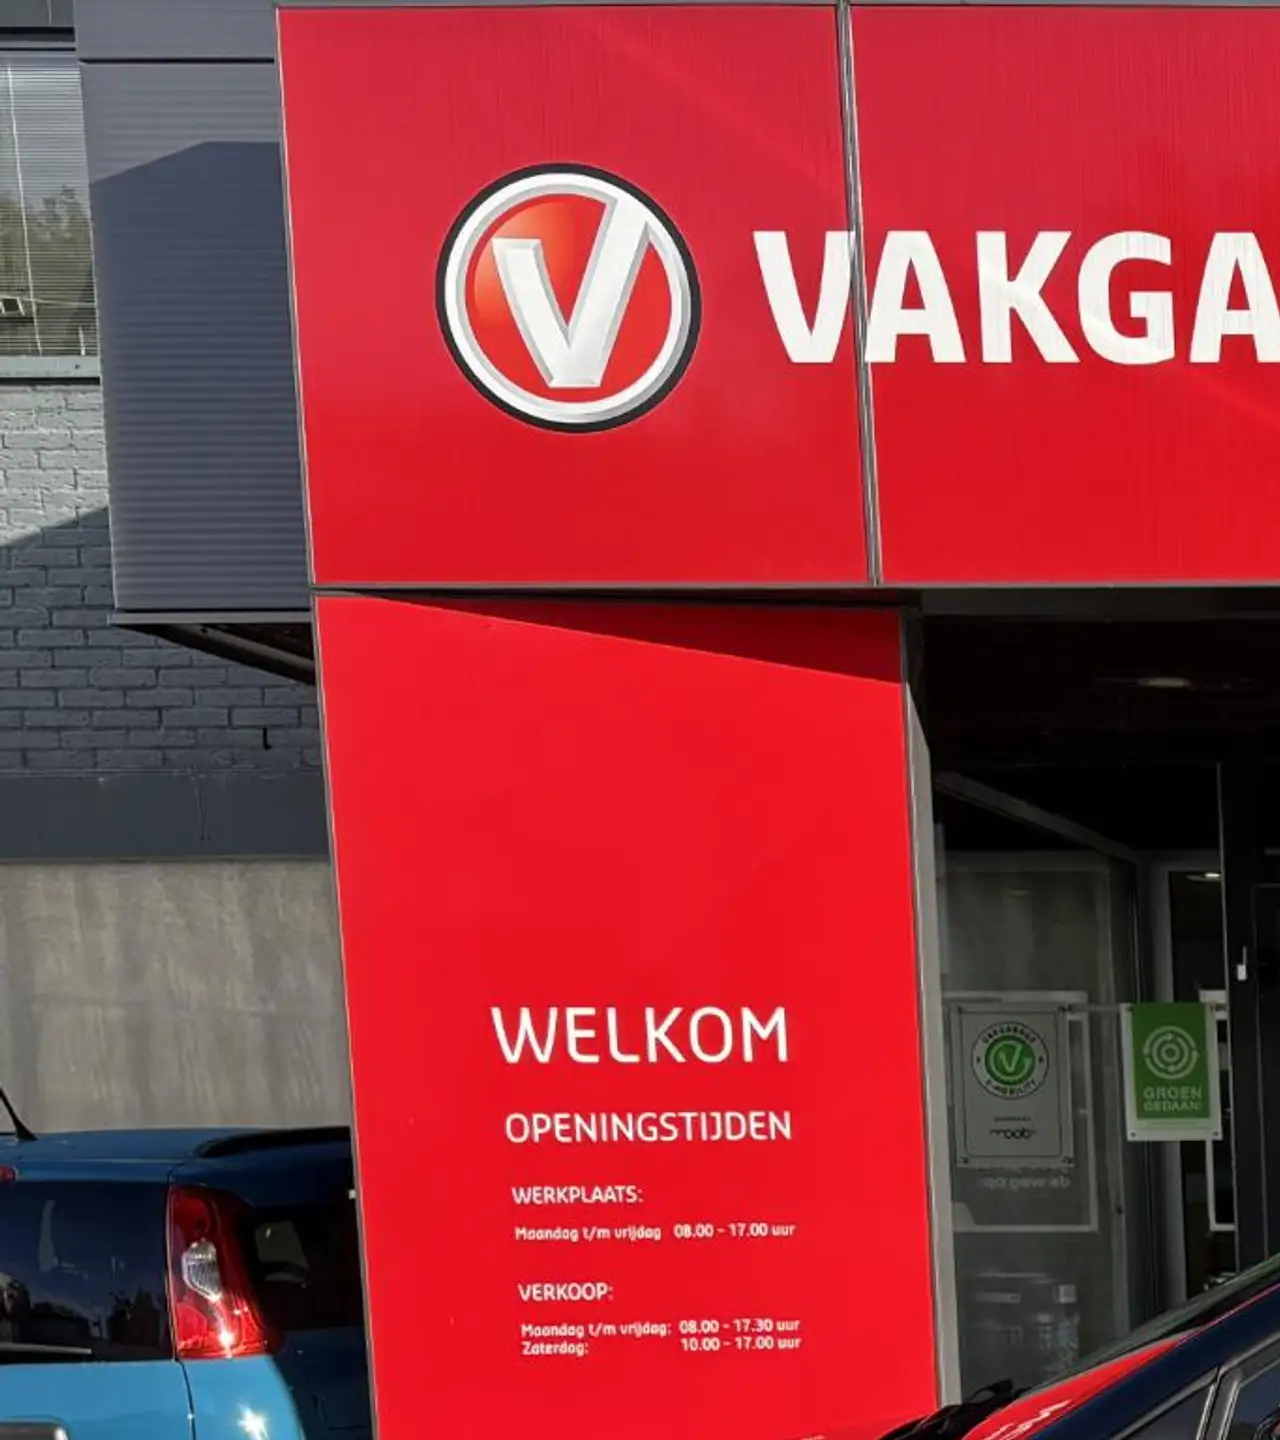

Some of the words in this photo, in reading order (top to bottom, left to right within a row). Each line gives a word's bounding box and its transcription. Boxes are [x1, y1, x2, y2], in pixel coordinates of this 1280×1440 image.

[490, 1006, 788, 1064] WELKOM
[1142, 1084, 1203, 1100] GROEN
[505, 1111, 792, 1143] OPENINGSTIJDEN
[511, 1185, 643, 1205] WERKPLAATS:
[515, 1227, 579, 1243] Maandag
[582, 1226, 611, 1242] t/m
[614, 1225, 662, 1243] vrijdag
[673, 1223, 714, 1239] 08.00
[728, 1222, 768, 1237] 17.00
[771, 1225, 797, 1237] uur
[517, 1282, 614, 1301] VERKOOP:
[521, 1323, 585, 1338] Maandag
[588, 1322, 617, 1336] t/m
[619, 1321, 672, 1337] vrijdag:
[678, 1319, 720, 1334] 08.00
[733, 1318, 774, 1333] 17.30
[776, 1320, 801, 1332] uur
[521, 1340, 589, 1357] Zaterdag:
[681, 1336, 721, 1352] 10.00
[735, 1335, 775, 1350] 17.00
[777, 1337, 803, 1350] uur
